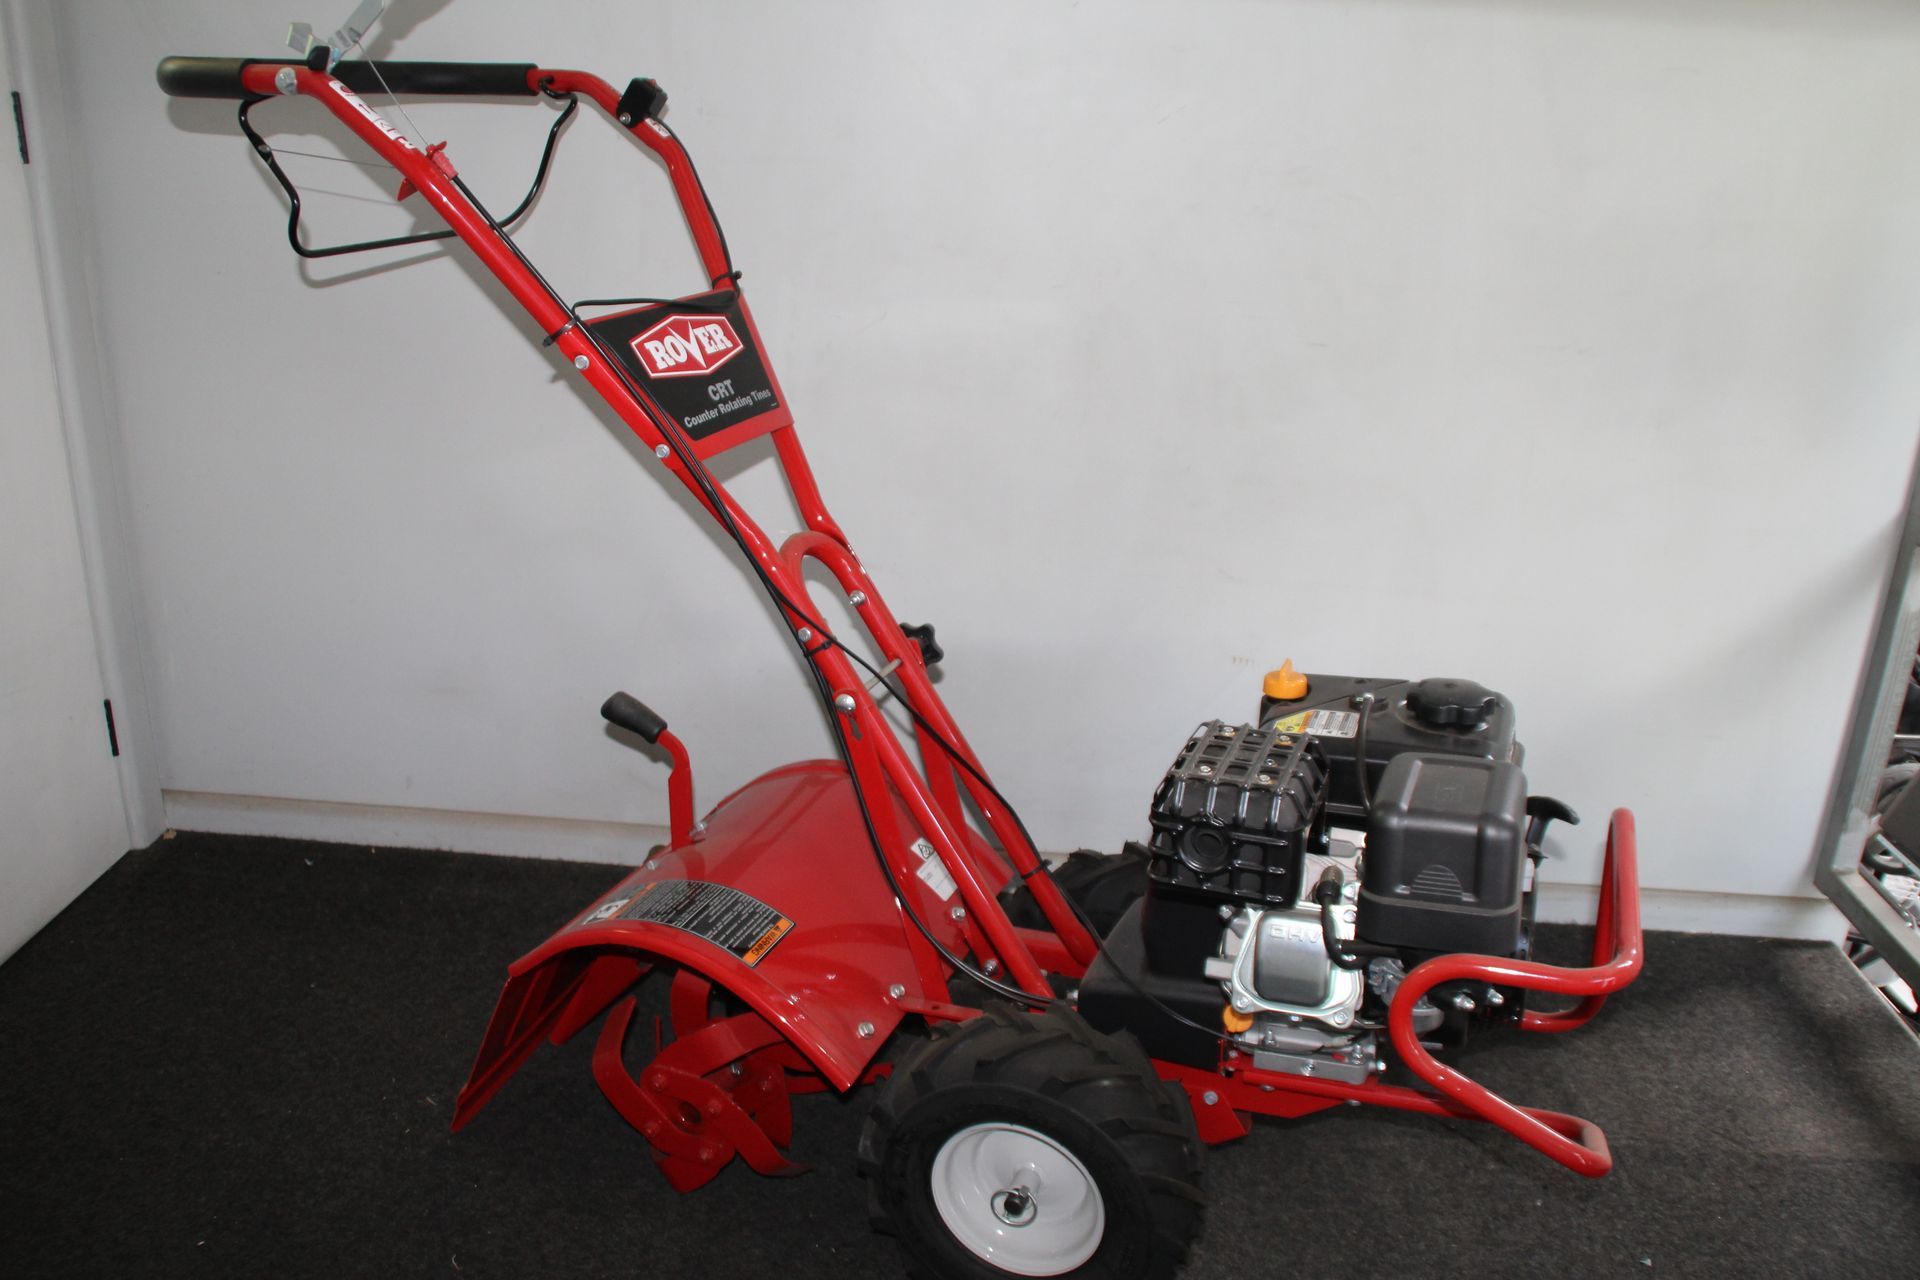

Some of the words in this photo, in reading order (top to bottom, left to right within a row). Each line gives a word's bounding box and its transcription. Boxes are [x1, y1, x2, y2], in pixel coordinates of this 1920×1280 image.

[644, 320, 733, 369] ROVER
[708, 379, 735, 401] CRT
[684, 408, 719, 428] Counter
[718, 396, 753, 415] Rotating
[751, 389, 771, 402] Tines
[751, 930, 777, 955] WARNING
